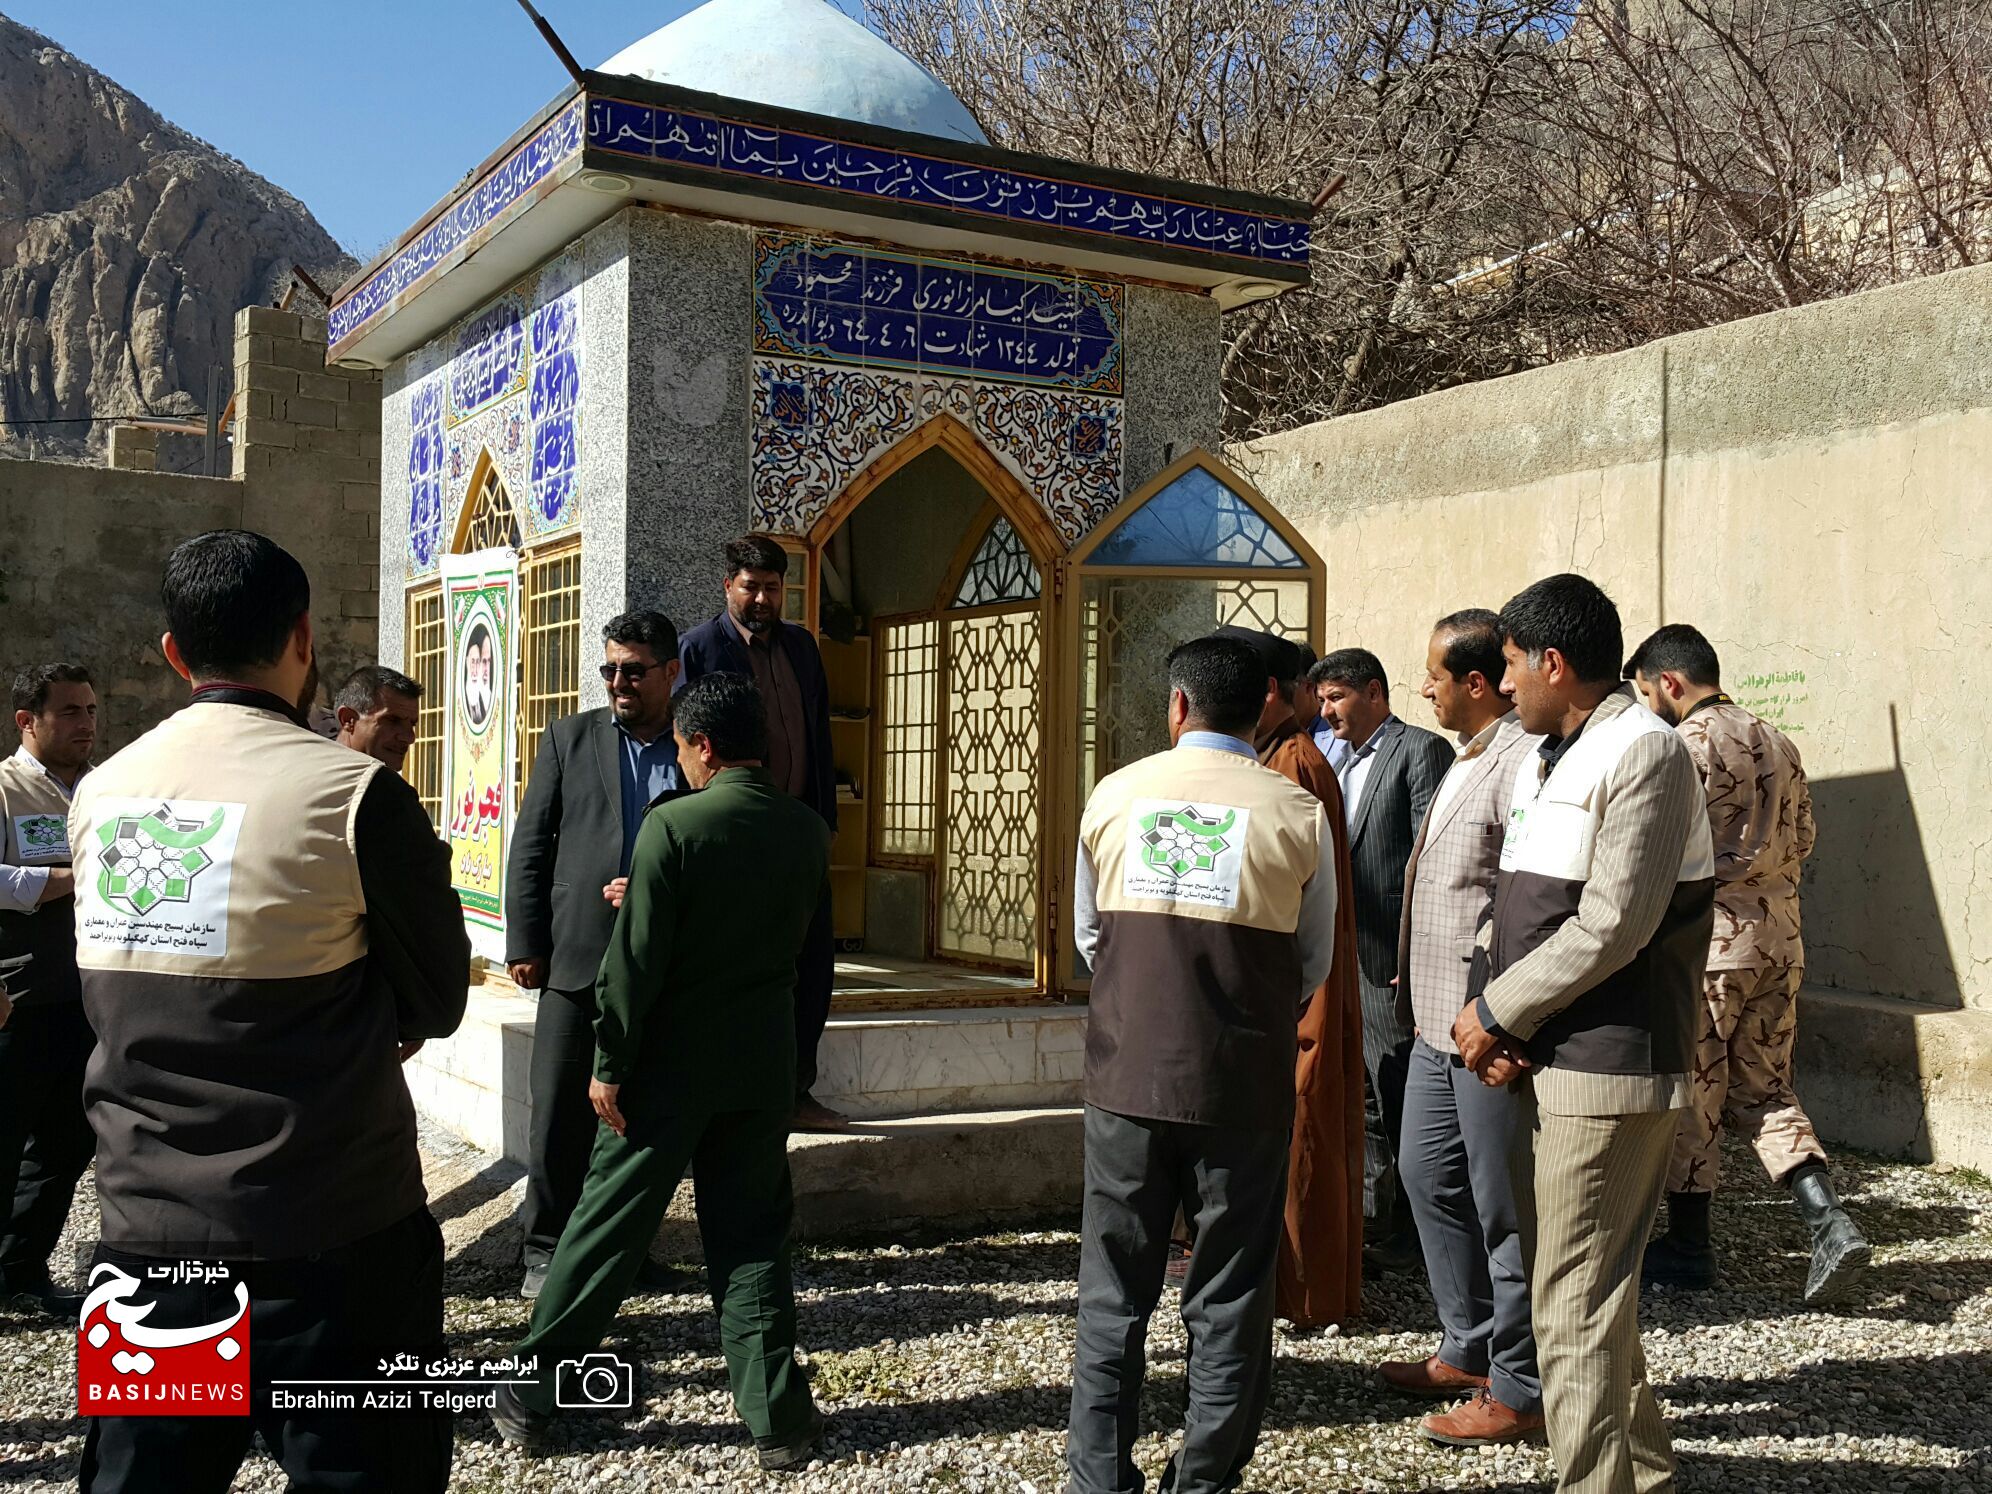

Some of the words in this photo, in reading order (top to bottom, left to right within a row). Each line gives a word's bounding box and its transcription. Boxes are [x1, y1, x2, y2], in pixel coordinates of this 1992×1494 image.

[795, 261, 852, 293] محمود
[860, 269, 902, 304] فرزند
[924, 325, 990, 357] شهادت
[128, 920, 163, 930] مهندسین
[164, 921, 183, 931] بسیج
[185, 923, 216, 934] سازمان
[150, 935, 172, 945] استان
[173, 937, 187, 947] فتح
[189, 938, 207, 949] سپاه
